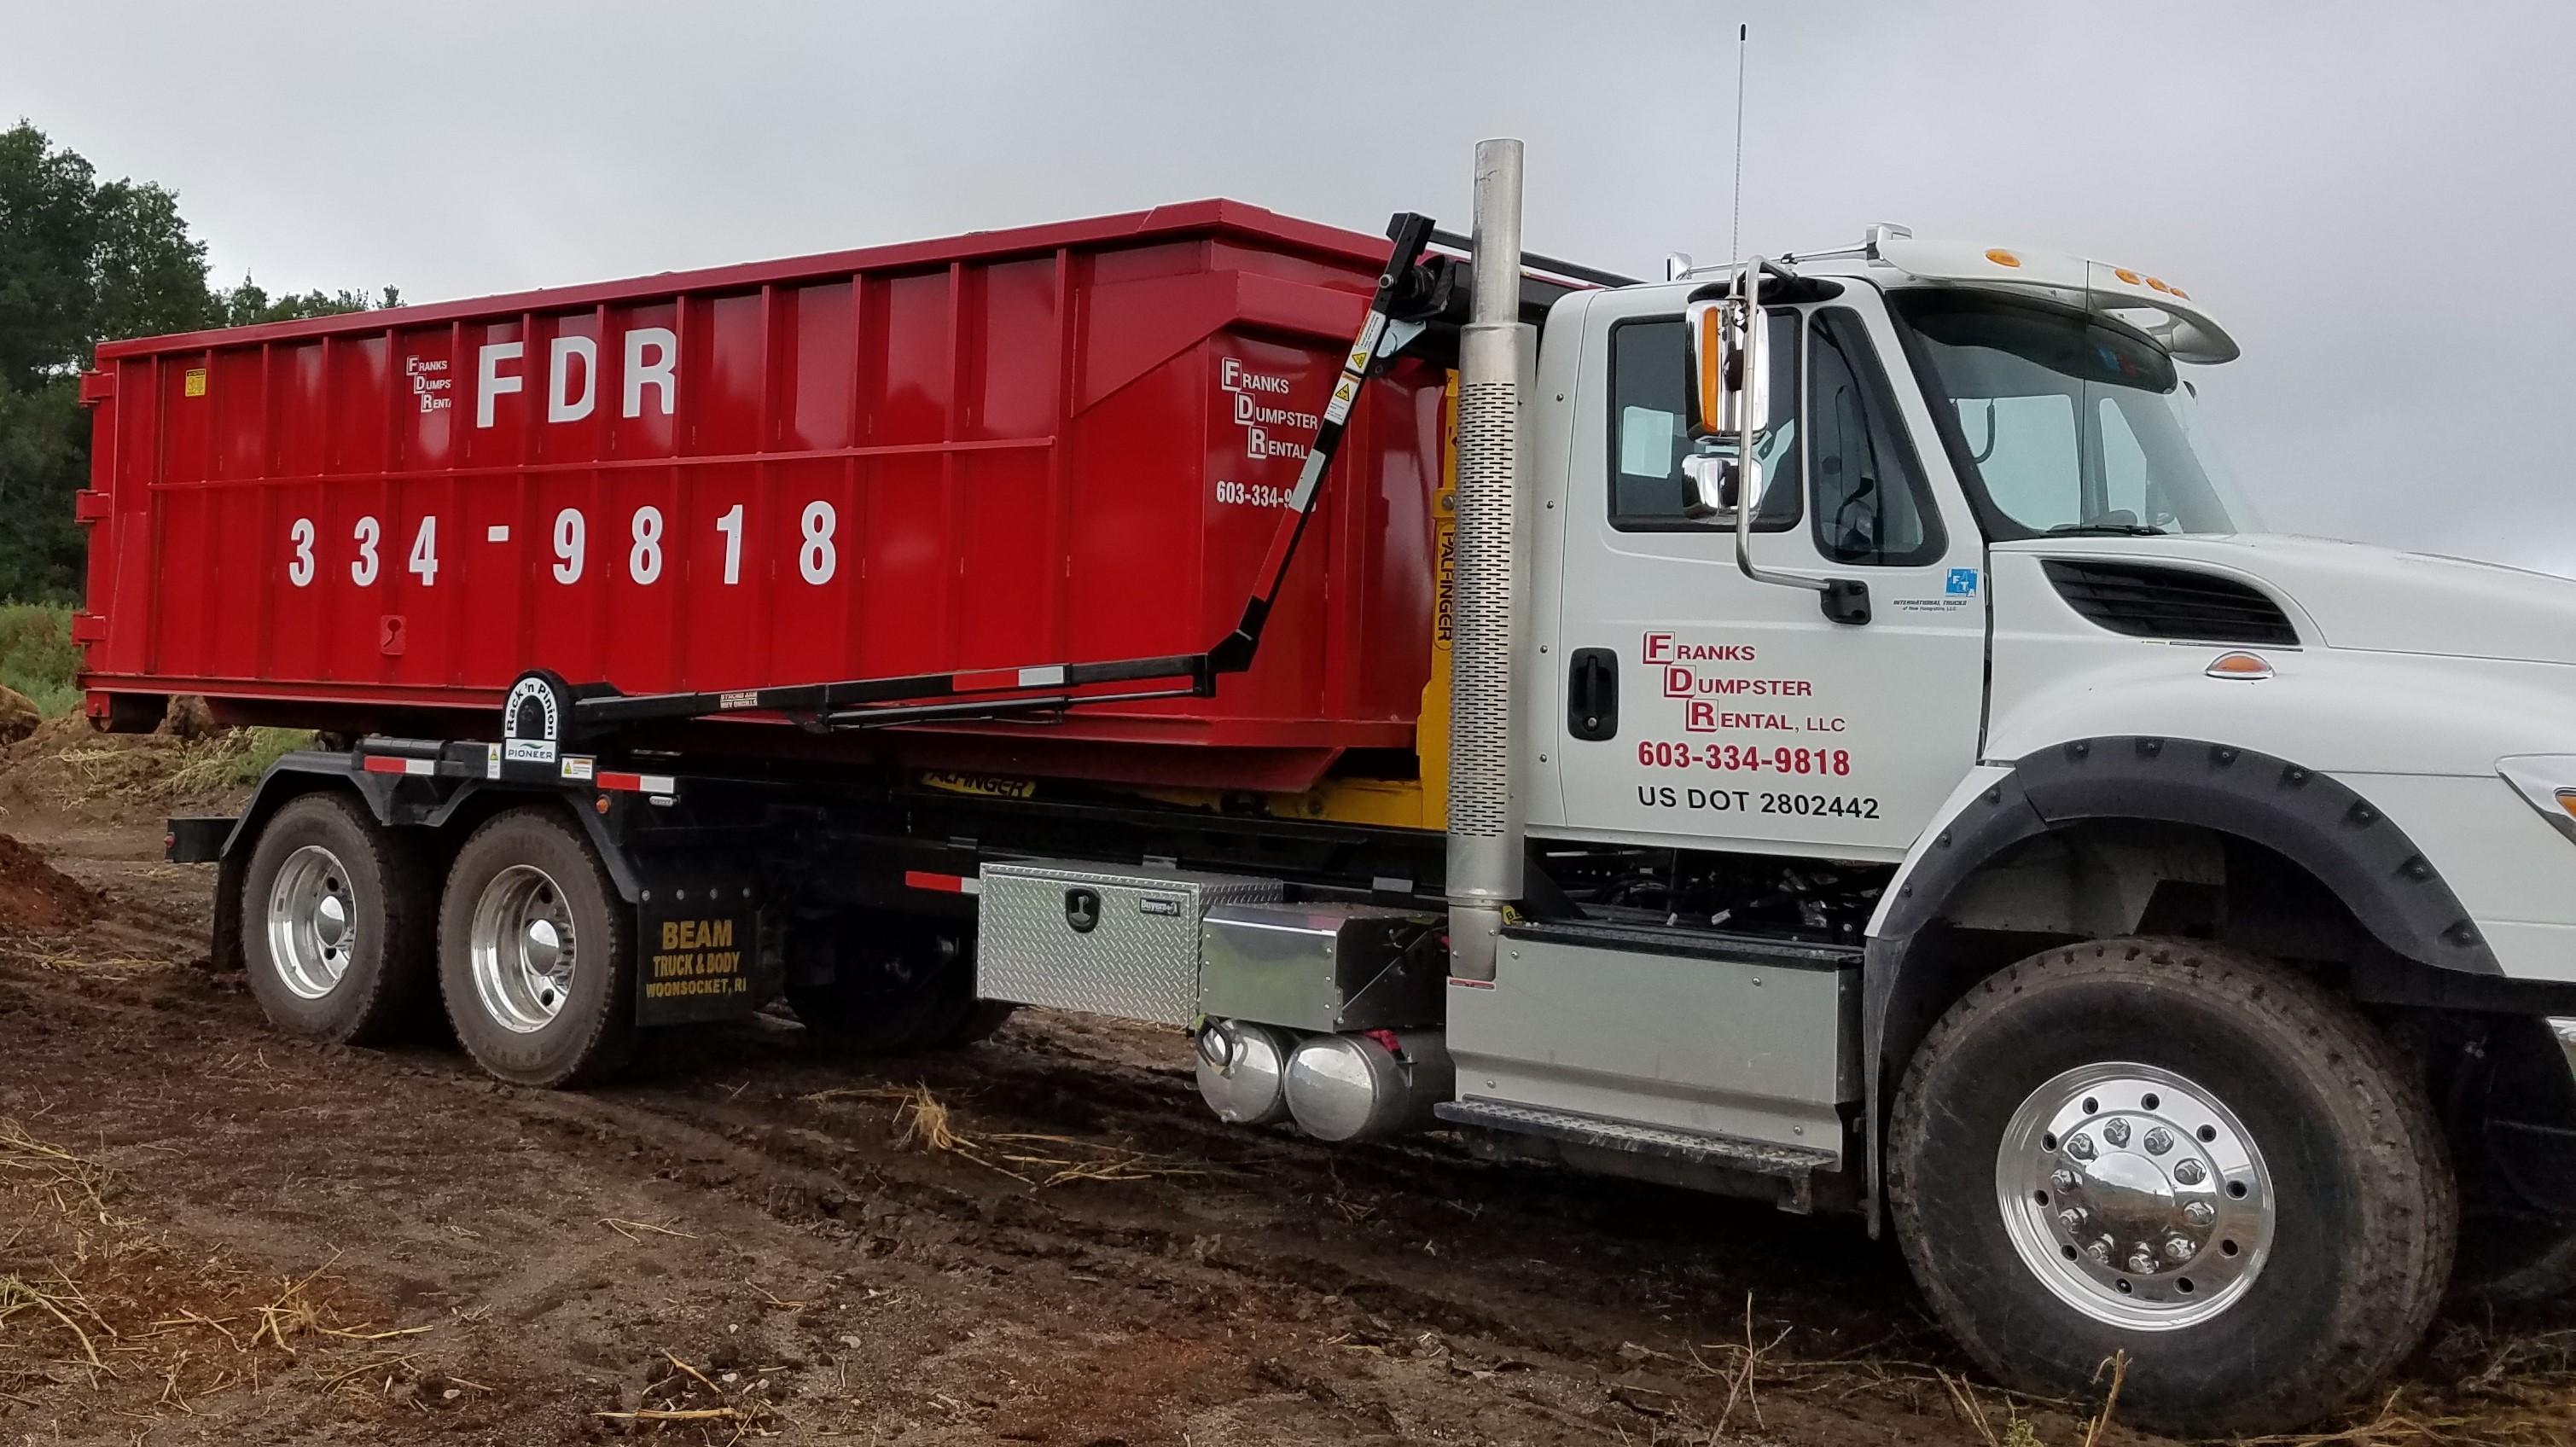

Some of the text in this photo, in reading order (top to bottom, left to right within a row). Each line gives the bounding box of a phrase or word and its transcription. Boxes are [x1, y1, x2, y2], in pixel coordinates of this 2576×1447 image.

[408, 356, 448, 374] FRANKS
[1224, 359, 1289, 393] FRANKS
[415, 375, 451, 392] DUMPS
[422, 393, 451, 410] RENT
[1237, 393, 1318, 430] DUMPSTER
[1250, 428, 1308, 459] RENTAL
[1217, 480, 1316, 512] 603-334-9
[1645, 633, 1756, 663] FRANKS
[1666, 666, 1812, 697] DUMPSTER
[506, 690, 524, 731] Rack
[538, 683, 555, 736] Pinion
[1689, 700, 1846, 734] RENTAL, LLC
[508, 749, 553, 759] PIONEER
[1637, 741, 1851, 776] 603-334-9818
[1637, 785, 1880, 819] US DOT 2802442
[662, 920, 732, 950] BEAM
[653, 951, 741, 978] TRUCK & BODY
[646, 977, 747, 998] WOONSOCKET, RI
